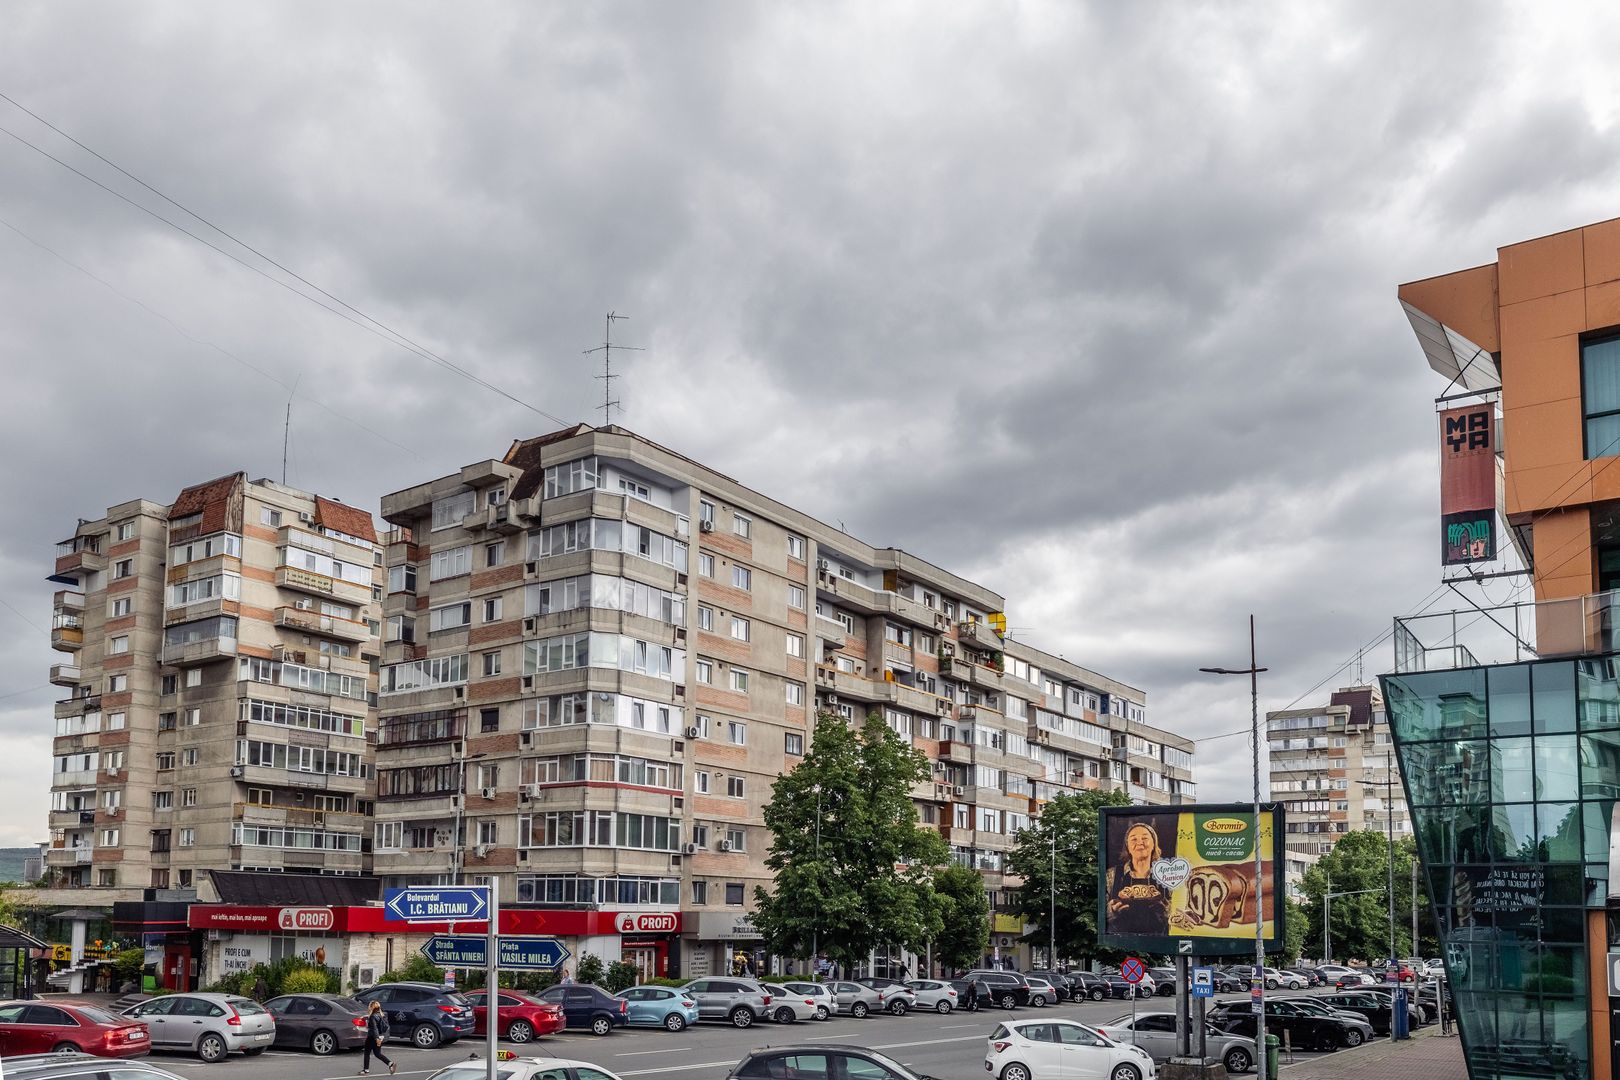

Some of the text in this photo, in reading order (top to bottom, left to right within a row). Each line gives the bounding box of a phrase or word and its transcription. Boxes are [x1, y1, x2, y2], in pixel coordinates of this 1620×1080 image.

[1206, 820, 1244, 830] Boromir
[1203, 837, 1246, 846] COZONAC
[1157, 864, 1186, 874] Aprobat
[407, 893, 440, 902] Bulevardul
[410, 902, 468, 915] I.C. BRĂTIANU
[299, 913, 328, 926] PROFI
[641, 917, 672, 929] PROFI
[435, 940, 454, 949] Strada
[501, 942, 519, 952] Piața
[435, 949, 484, 962] SFÂNTA VINERI
[501, 952, 551, 964] VASILE MILEA
